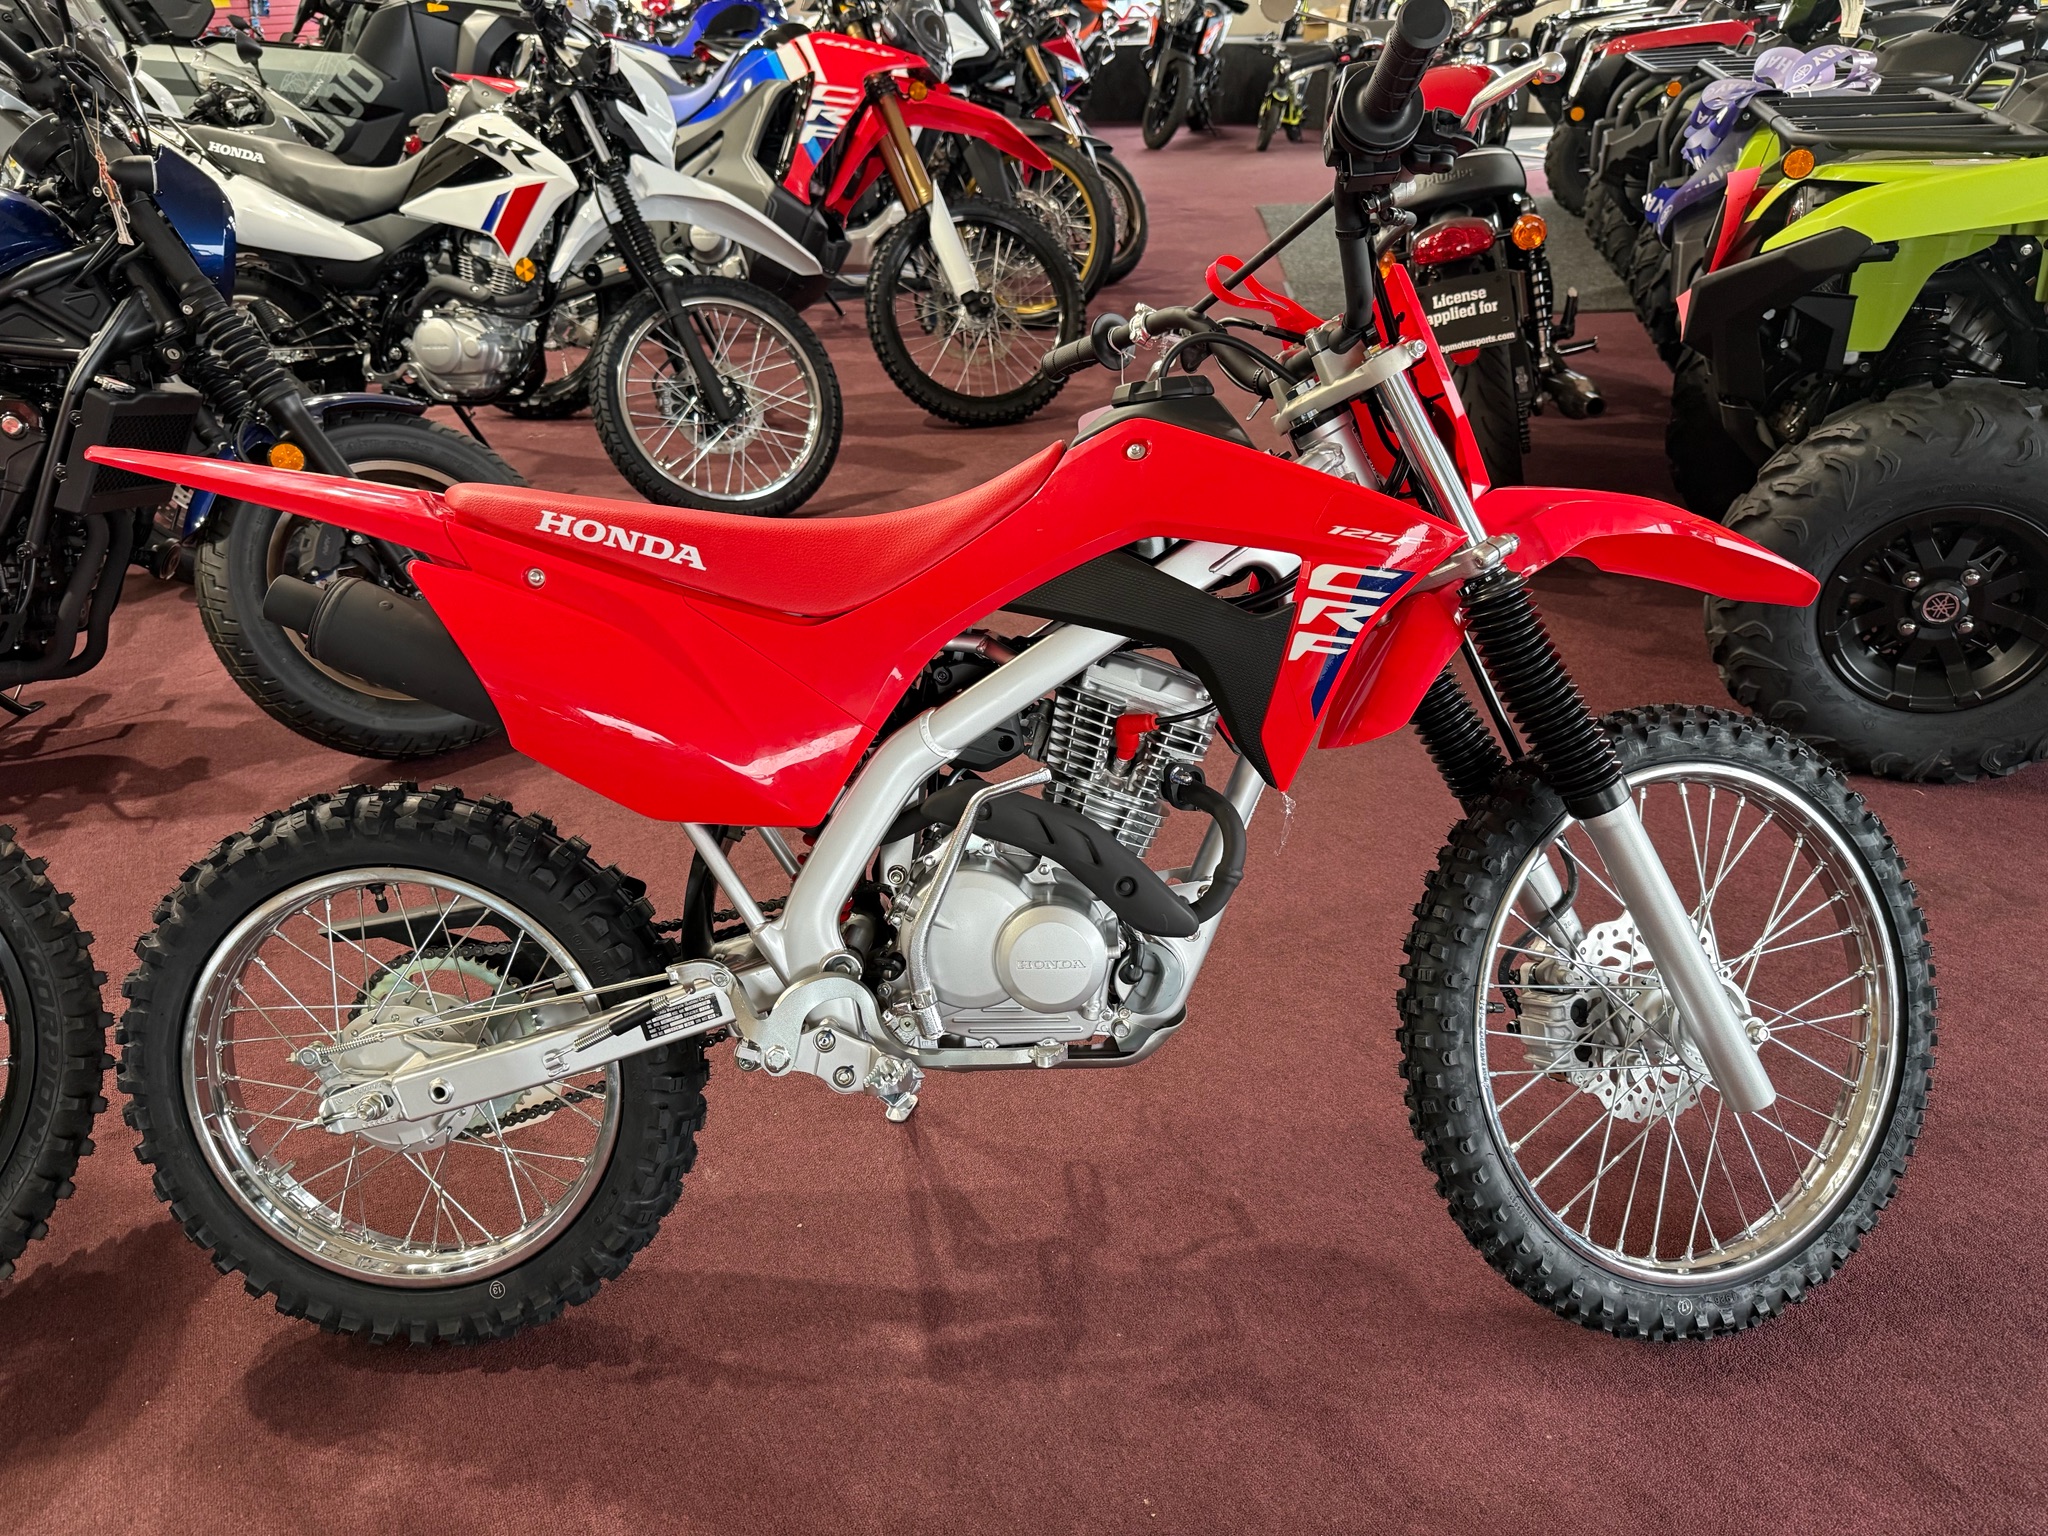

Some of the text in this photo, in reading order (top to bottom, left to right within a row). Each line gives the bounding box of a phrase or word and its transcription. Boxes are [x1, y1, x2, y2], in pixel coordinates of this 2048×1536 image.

[207, 141, 266, 164] HONDA
[467, 126, 541, 172] XR
[1432, 288, 1487, 310] License
[1427, 301, 1498, 328] applied for
[534, 510, 707, 571] HONDA
[1327, 525, 1432, 546] 125F
[1288, 563, 1403, 661] CRF
[1016, 959, 1087, 970] HONDA
